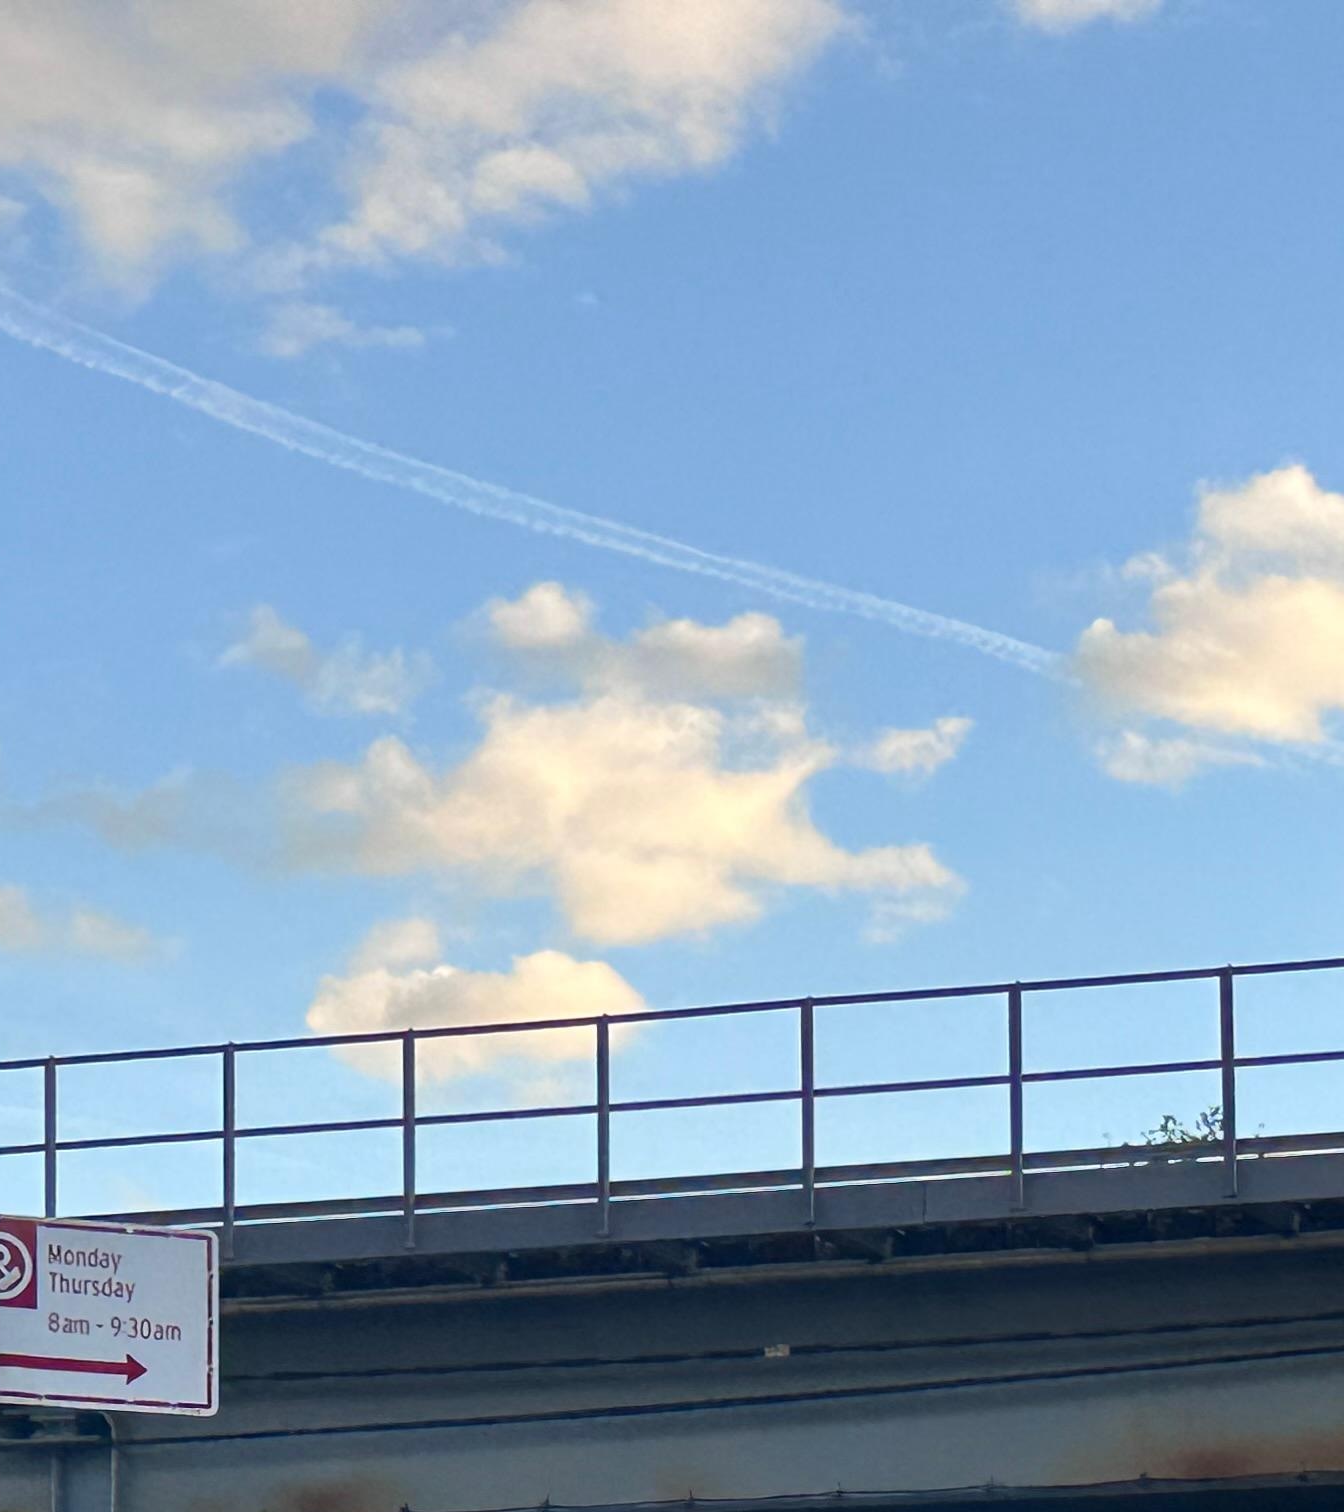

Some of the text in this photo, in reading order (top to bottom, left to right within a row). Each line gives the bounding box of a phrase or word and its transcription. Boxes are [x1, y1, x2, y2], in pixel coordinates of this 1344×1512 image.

[48, 1244, 122, 1272] Monday
[49, 1272, 135, 1302] Thursday
[48, 1313, 90, 1335] 8am
[110, 1317, 182, 1342] 9:30am
